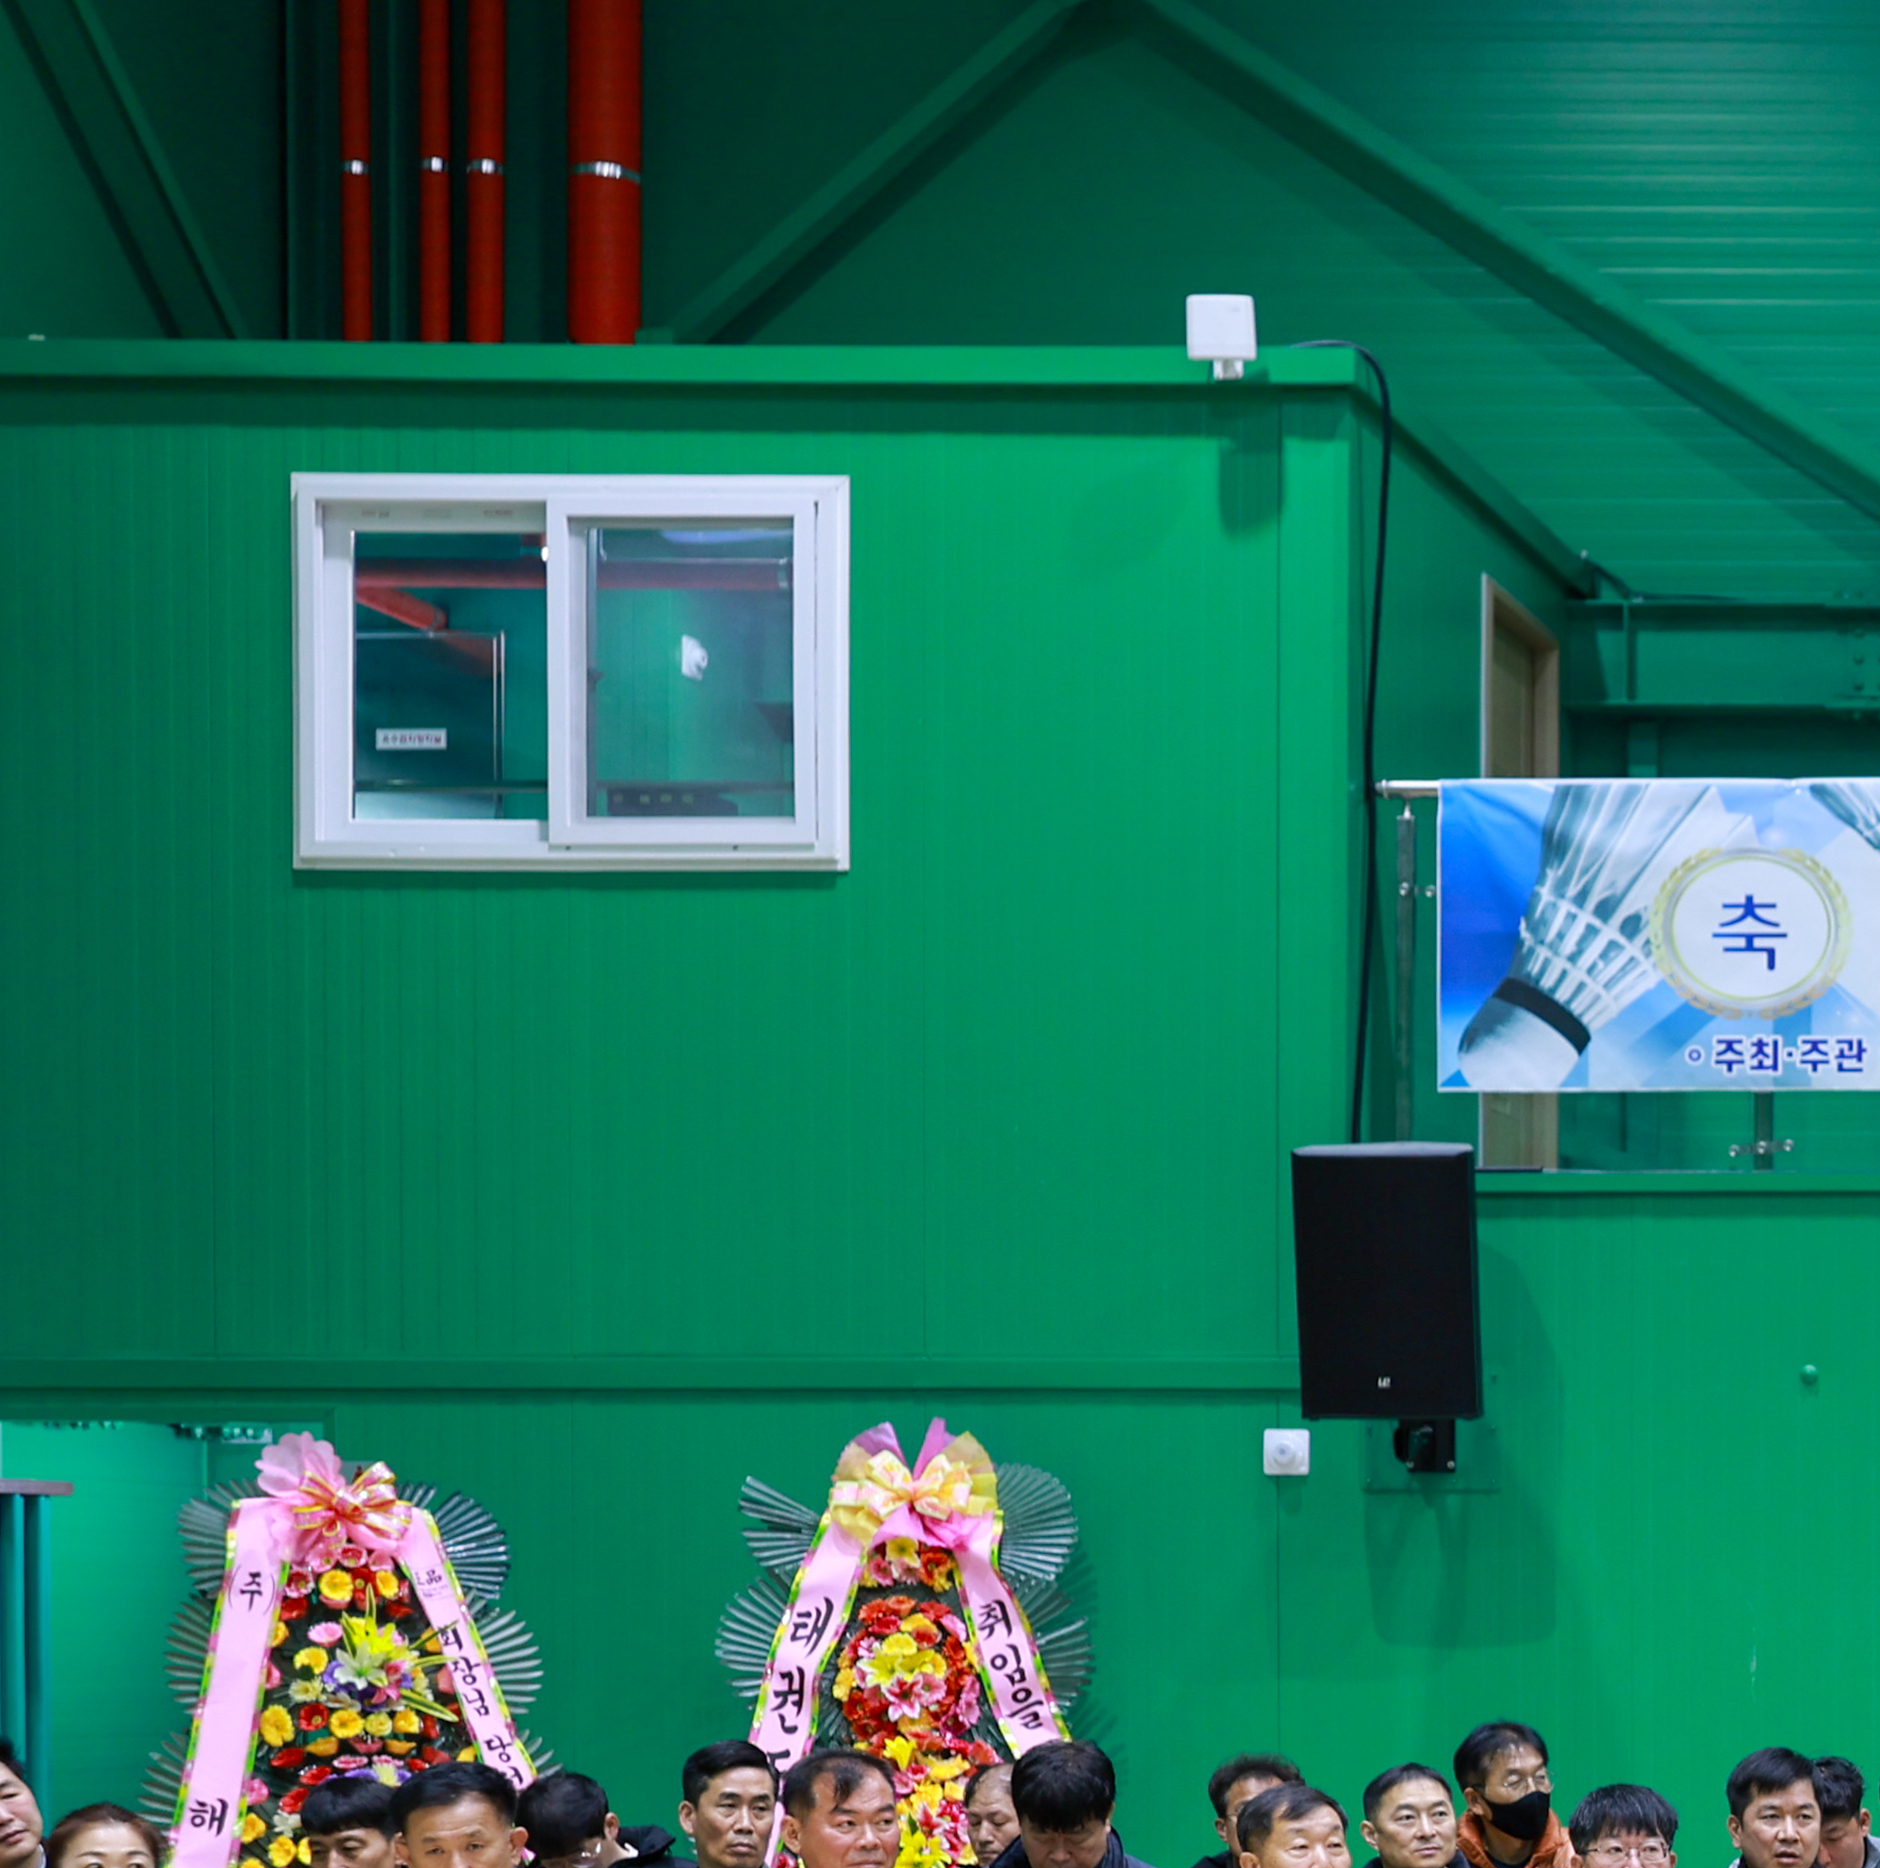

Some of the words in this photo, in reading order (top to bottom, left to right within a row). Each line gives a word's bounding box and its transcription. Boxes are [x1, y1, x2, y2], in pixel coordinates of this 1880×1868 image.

[1711, 893, 1788, 972] 축
[228, 1568, 276, 1614] (주)
[977, 1599, 1044, 1732] 취임을
